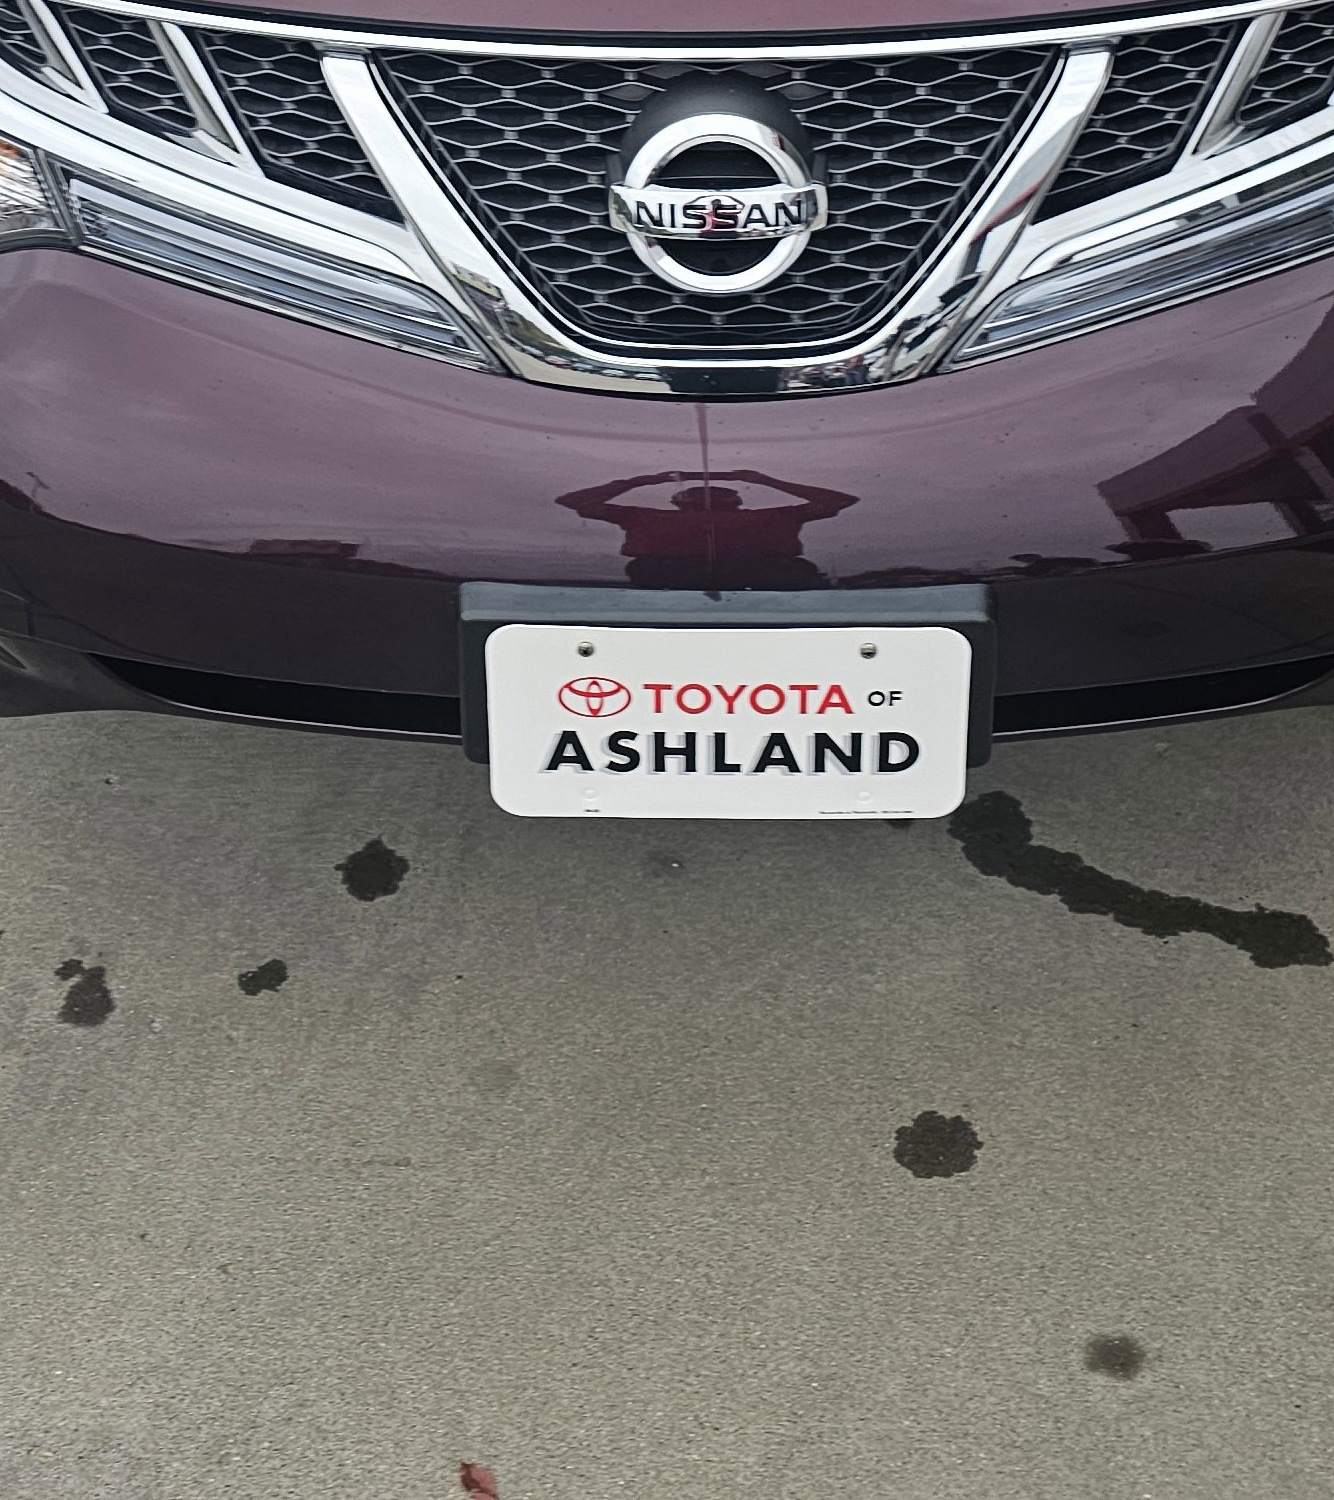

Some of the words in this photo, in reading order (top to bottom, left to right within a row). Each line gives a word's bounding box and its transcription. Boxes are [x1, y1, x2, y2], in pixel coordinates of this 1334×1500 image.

[634, 200, 803, 229] NISSAN
[643, 683, 856, 715] TOYOTA
[867, 690, 904, 708] OF
[543, 729, 921, 774] ASHLAND
